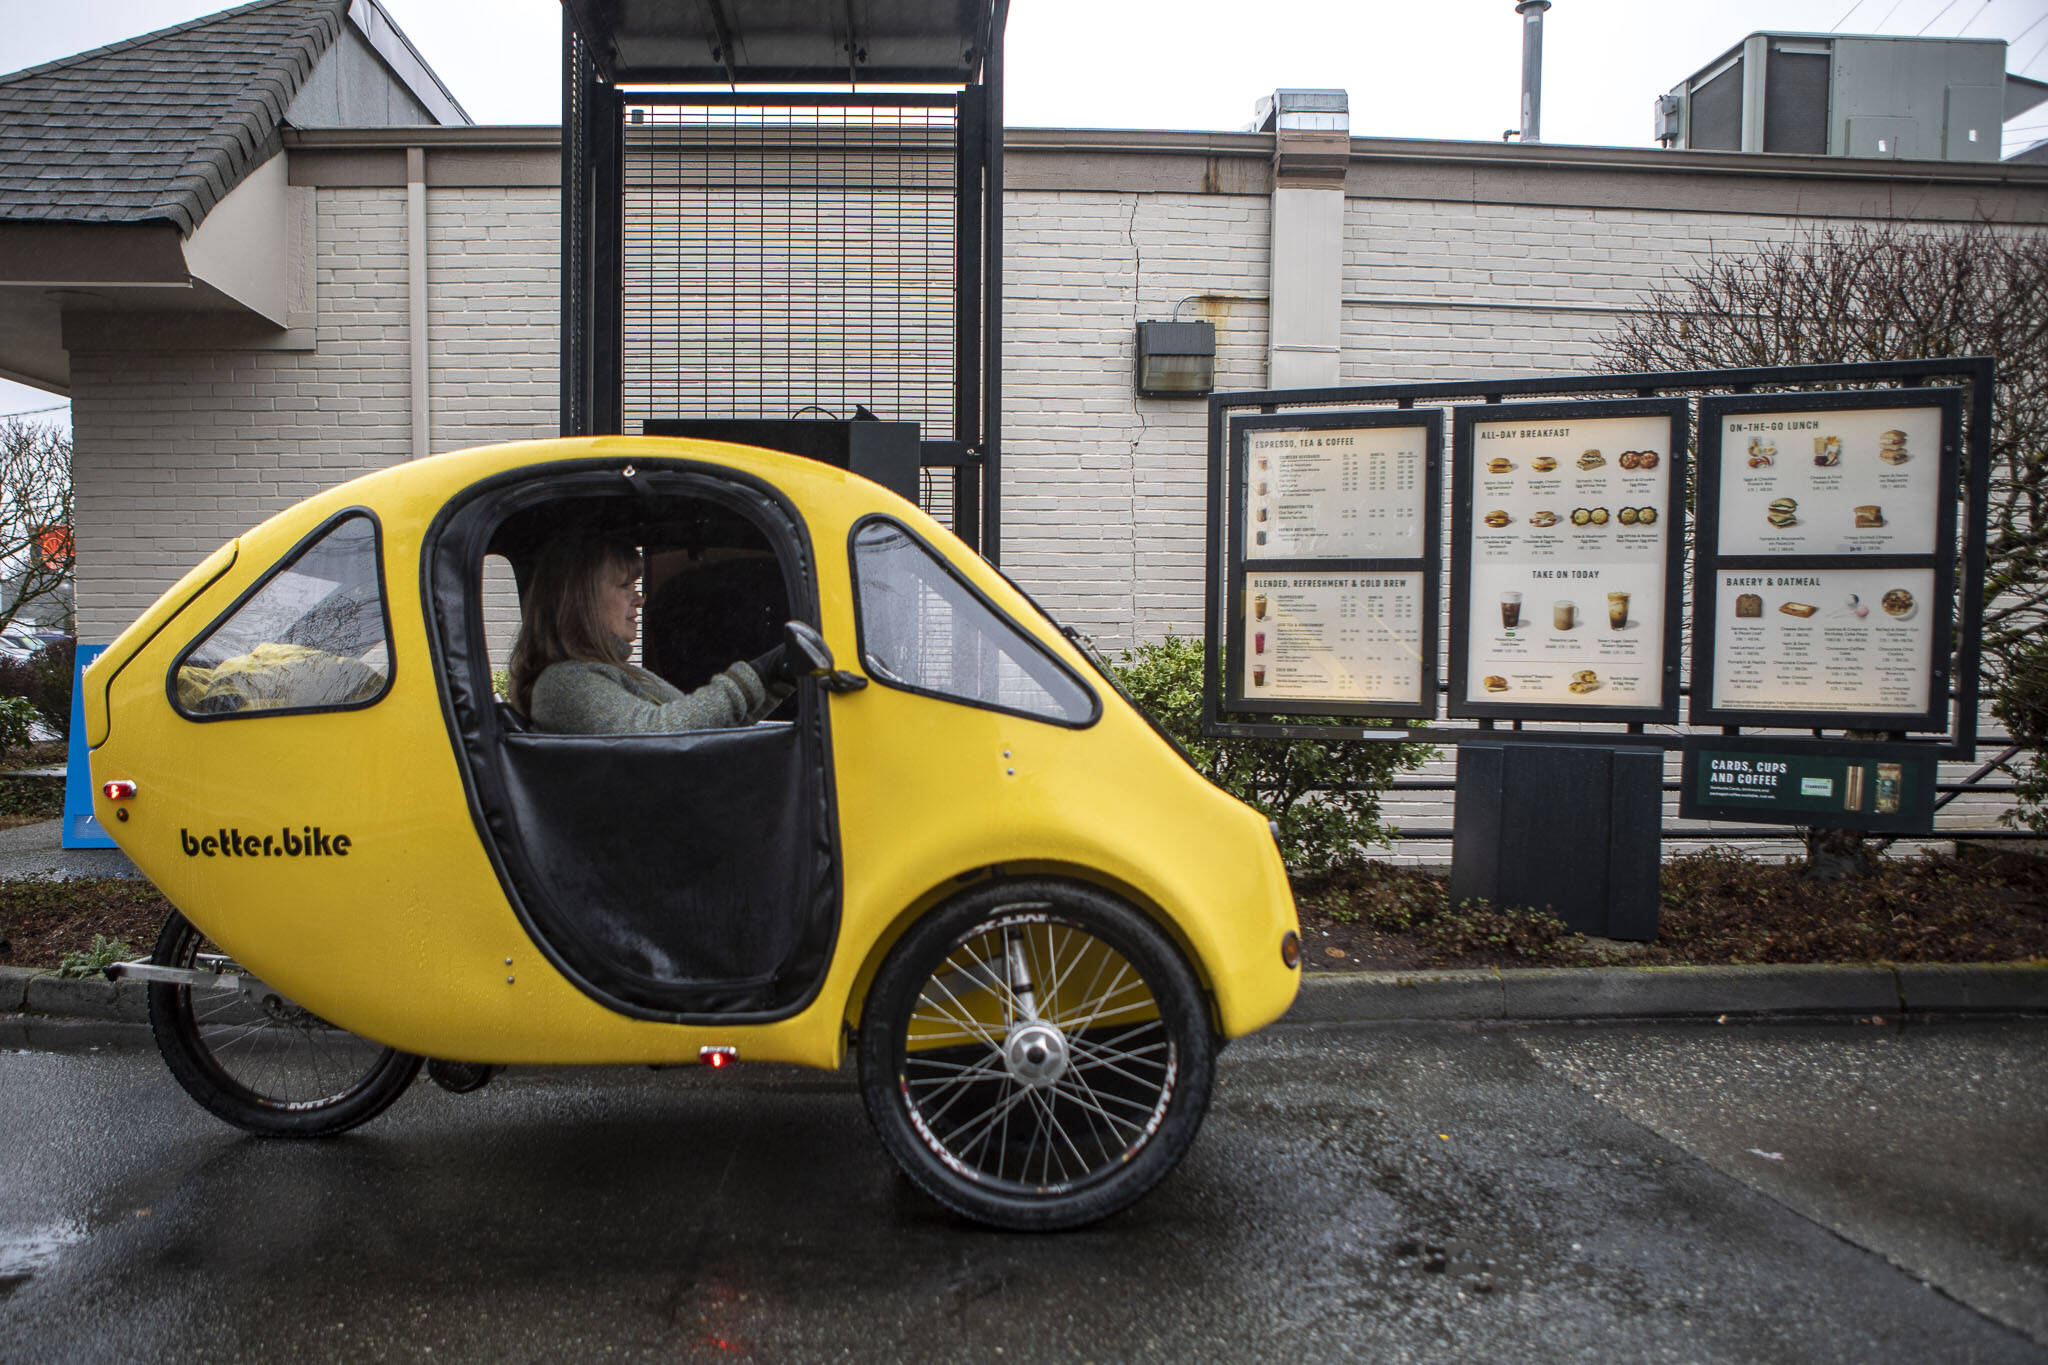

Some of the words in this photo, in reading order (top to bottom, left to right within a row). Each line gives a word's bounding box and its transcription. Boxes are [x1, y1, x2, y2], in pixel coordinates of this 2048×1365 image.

[1729, 422, 1784, 433] ON-THE-GO
[1787, 420, 1819, 431] LUNCH
[1480, 430, 1517, 440] ALL-DAY
[1520, 428, 1570, 438] BREAKFAST
[1255, 439, 1297, 449] ESPRESSO,
[1300, 438, 1314, 448] TEA
[1317, 438, 1323, 447] &
[1325, 437, 1355, 446] COFFEE
[1532, 570, 1553, 579] TAKE
[1556, 570, 1568, 579] ON
[1571, 570, 1600, 579] TODAY
[1254, 579, 1291, 588] BLENDED,
[1293, 579, 1349, 588] REFRESHMENT
[1351, 579, 1358, 588] &
[1360, 579, 1381, 588] COLD
[1383, 579, 1407, 588] BREW
[1726, 577, 1763, 586] BAKERY
[1766, 577, 1773, 586] &
[1777, 577, 1821, 586] OATMEAL
[1711, 759, 1753, 774] CARDS,
[1756, 761, 1788, 774] CUPS
[1710, 772, 1734, 783] AND
[1737, 773, 1778, 786] COFFEE
[180, 825, 352, 857] better.bike
[287, 1091, 347, 1110] MTX
